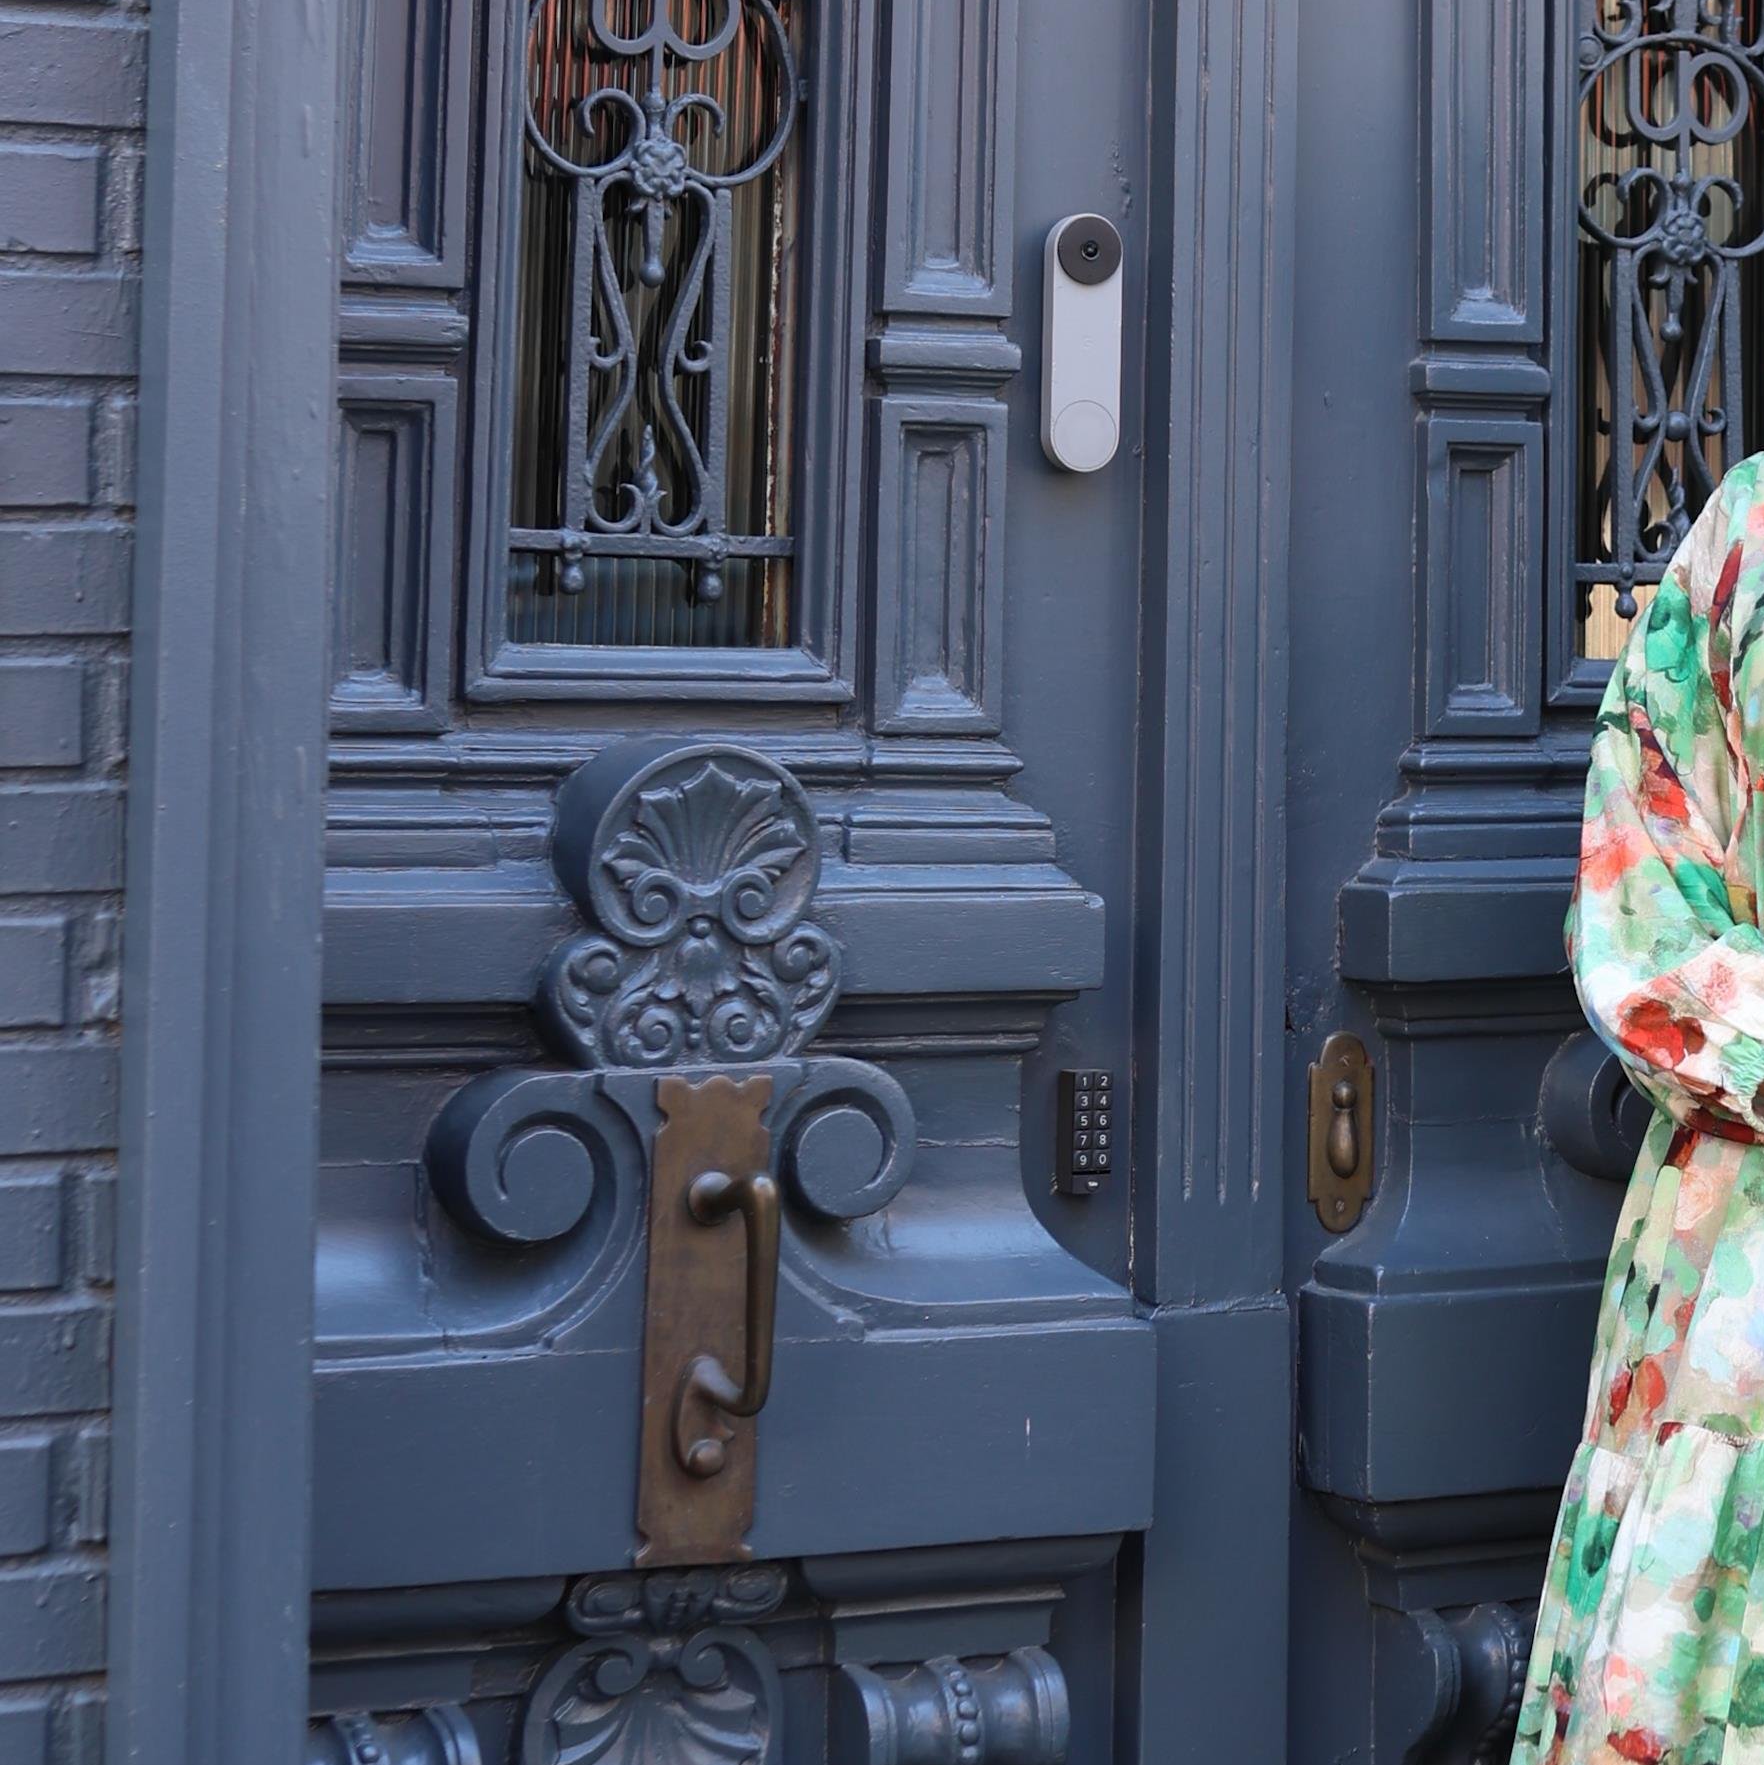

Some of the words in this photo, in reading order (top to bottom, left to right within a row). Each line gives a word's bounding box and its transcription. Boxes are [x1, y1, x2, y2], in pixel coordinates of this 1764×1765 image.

[1100, 1076, 1108, 1086] 2
[1081, 1096, 1088, 1106] 3
[1100, 1095, 1107, 1105] 4
[1080, 1116, 1088, 1126] 5
[1099, 1115, 1107, 1125] 6
[1080, 1135, 1087, 1146] 7
[1099, 1134, 1107, 1145] 8
[1080, 1155, 1087, 1165] 9
[1099, 1154, 1107, 1164] 0
